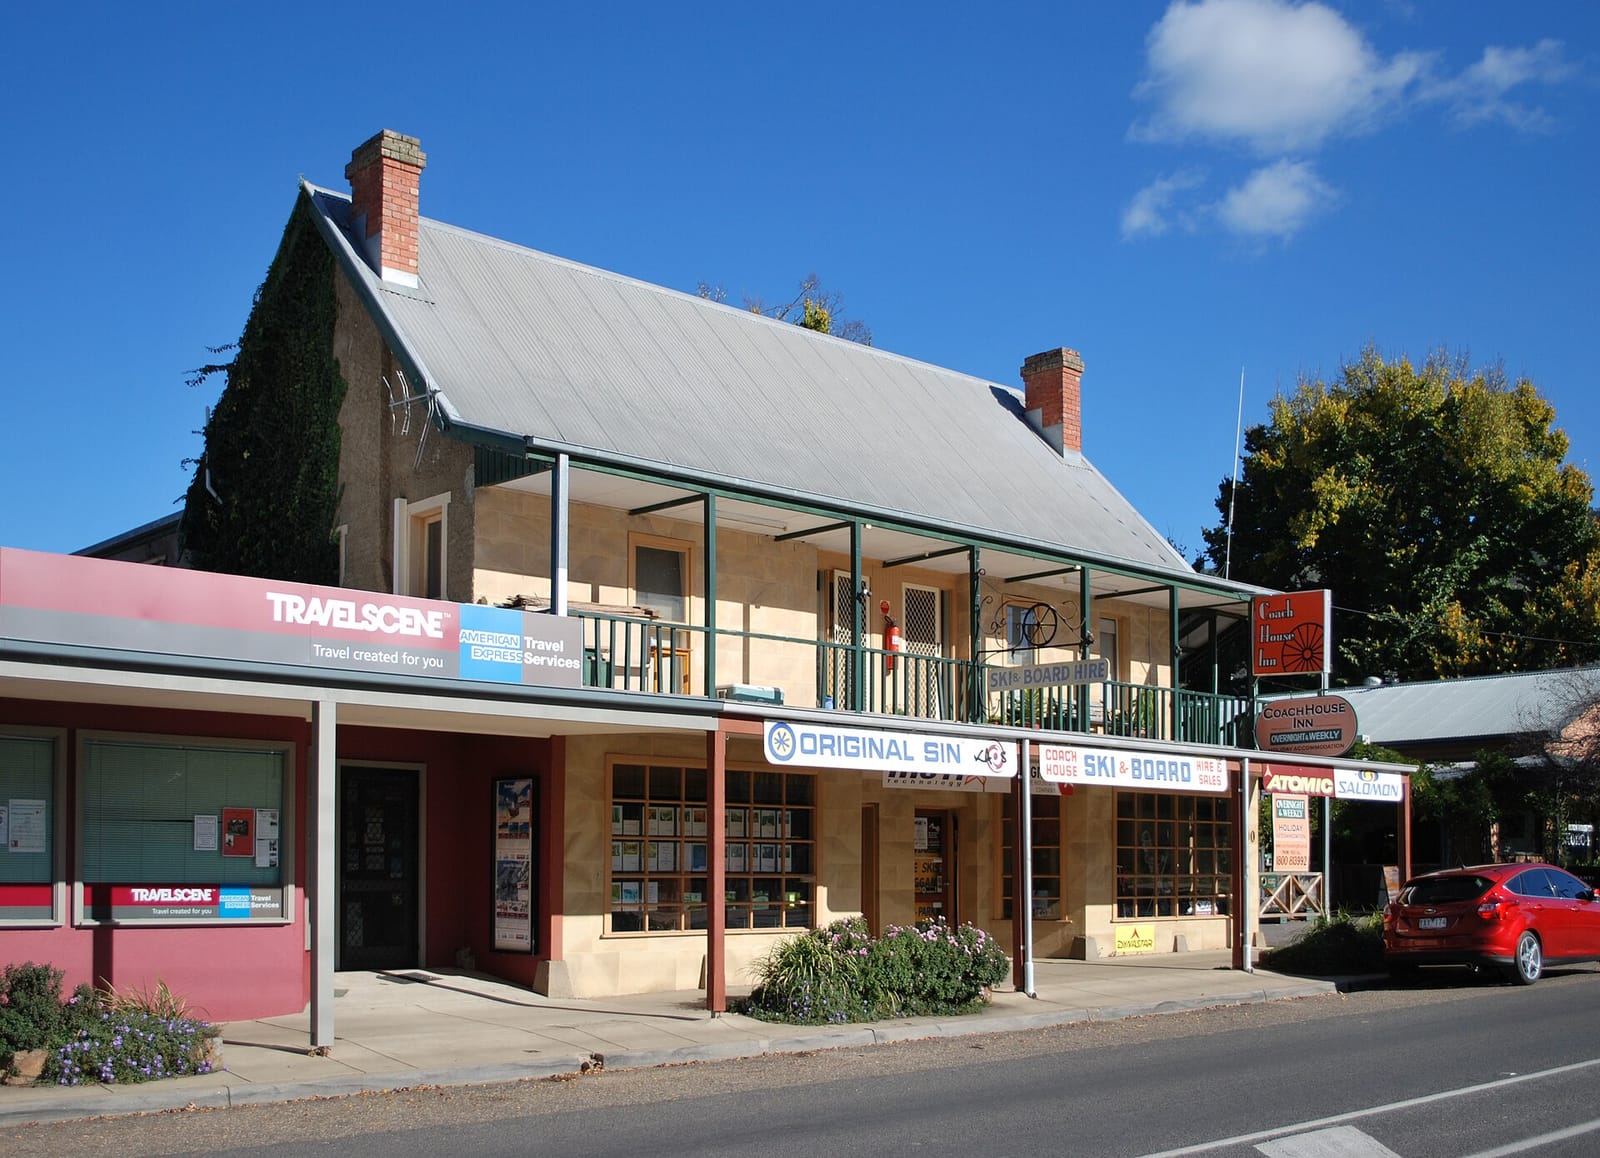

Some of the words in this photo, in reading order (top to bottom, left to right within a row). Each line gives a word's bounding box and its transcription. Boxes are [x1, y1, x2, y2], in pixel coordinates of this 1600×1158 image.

[266, 591, 444, 639] TRAVELSCENE
[1259, 599, 1294, 620] Coach
[460, 630, 520, 647] AMERICAN
[1259, 624, 1296, 643] House
[524, 636, 564, 653] Travel
[313, 643, 350, 660] Travel
[353, 648, 399, 664] created
[401, 651, 420, 665] for
[422, 656, 444, 670] you
[473, 647, 523, 663] EXPRESS
[524, 651, 581, 670] Services
[1258, 648, 1277, 667] Inn
[990, 671, 1012, 688] SKI
[1023, 666, 1070, 684] BOARD
[1074, 662, 1105, 679] HIRE
[1293, 718, 1314, 728] INN
[800, 732, 914, 761] ORIGINAL
[924, 741, 961, 764] SIN
[1045, 749, 1077, 763] COACH
[1046, 763, 1078, 777] HOUSE
[1083, 754, 1116, 778] SKI
[1119, 761, 1129, 774] &
[1131, 758, 1191, 783] BOARD
[1196, 760, 1217, 773] HIRE
[1198, 773, 1222, 786] SALES
[1266, 774, 1334, 795] ATOMIC
[1338, 780, 1399, 797] SALOMON
[1278, 824, 1304, 832] HOLIDAY
[131, 888, 213, 901] TRAVELSCENE
[152, 907, 169, 915] Travel
[169, 907, 192, 915] created
[192, 907, 201, 915] for
[201, 908, 213, 916] you
[251, 901, 280, 909] Services
